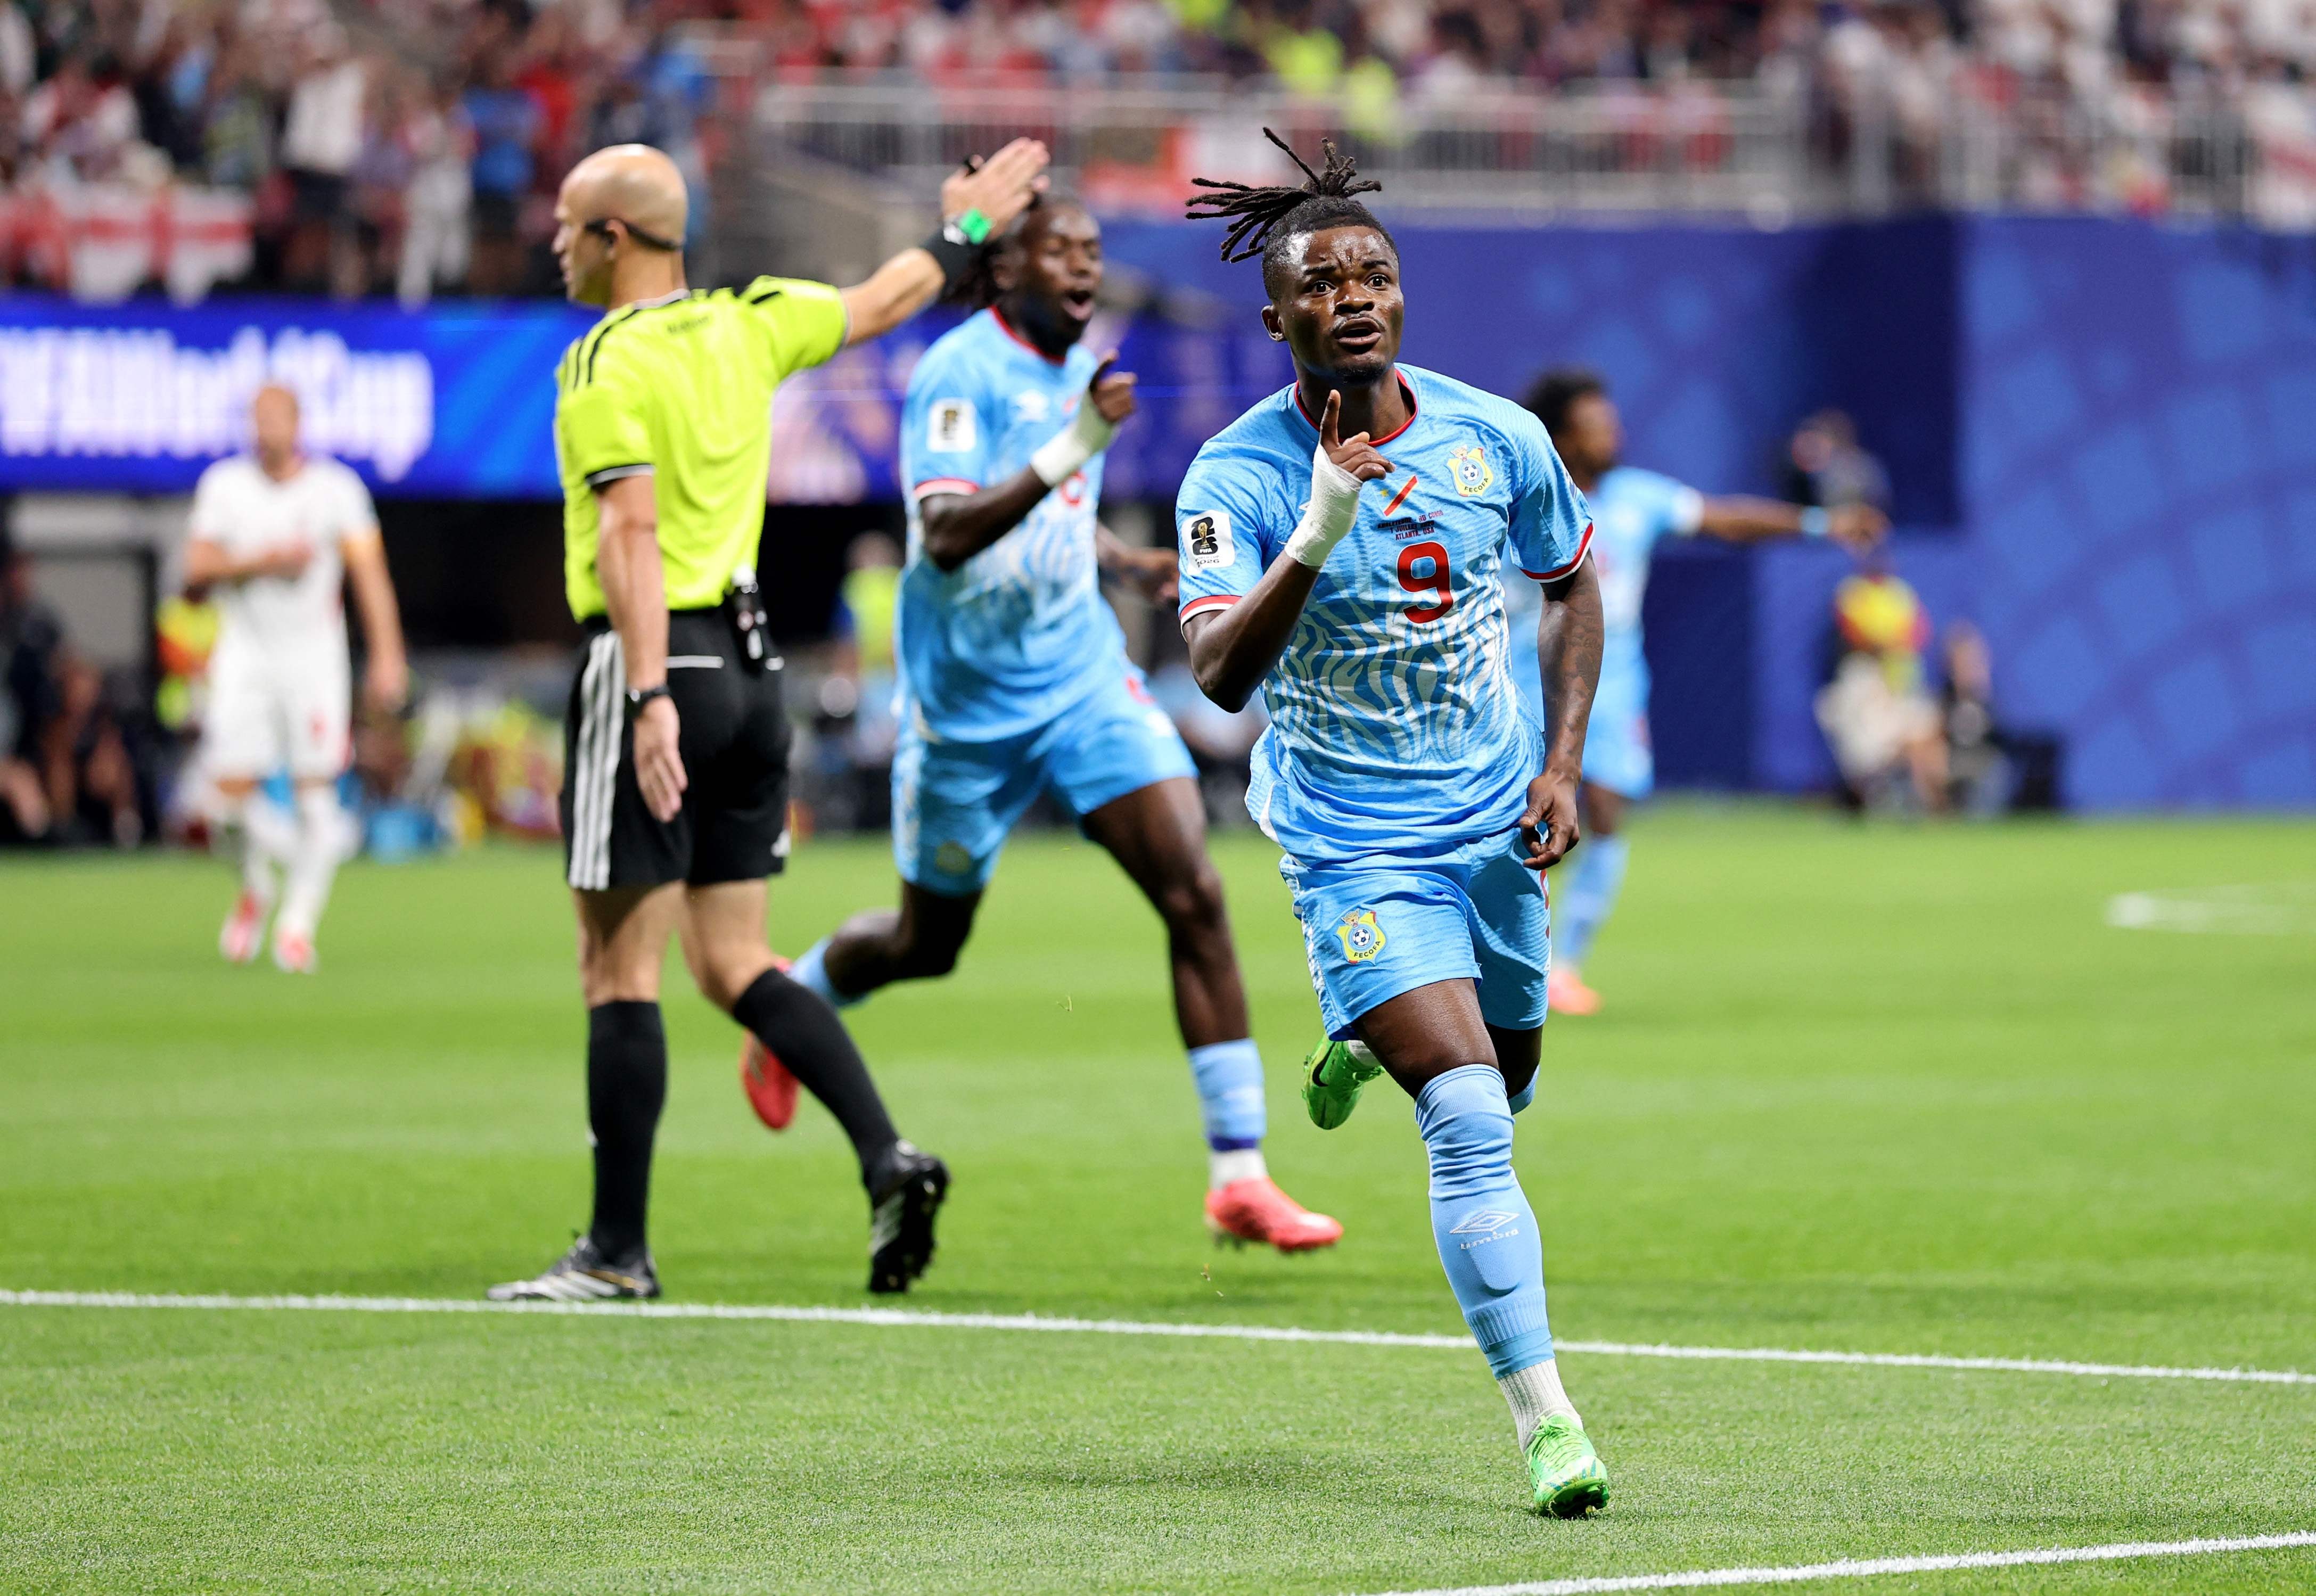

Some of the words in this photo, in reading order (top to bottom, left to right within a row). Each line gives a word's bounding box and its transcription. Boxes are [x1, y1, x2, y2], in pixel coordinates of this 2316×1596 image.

[1464, 478, 1488, 492] FECOFA
[1397, 541, 1453, 623] 9
[1354, 941, 1380, 958] FECOFA
